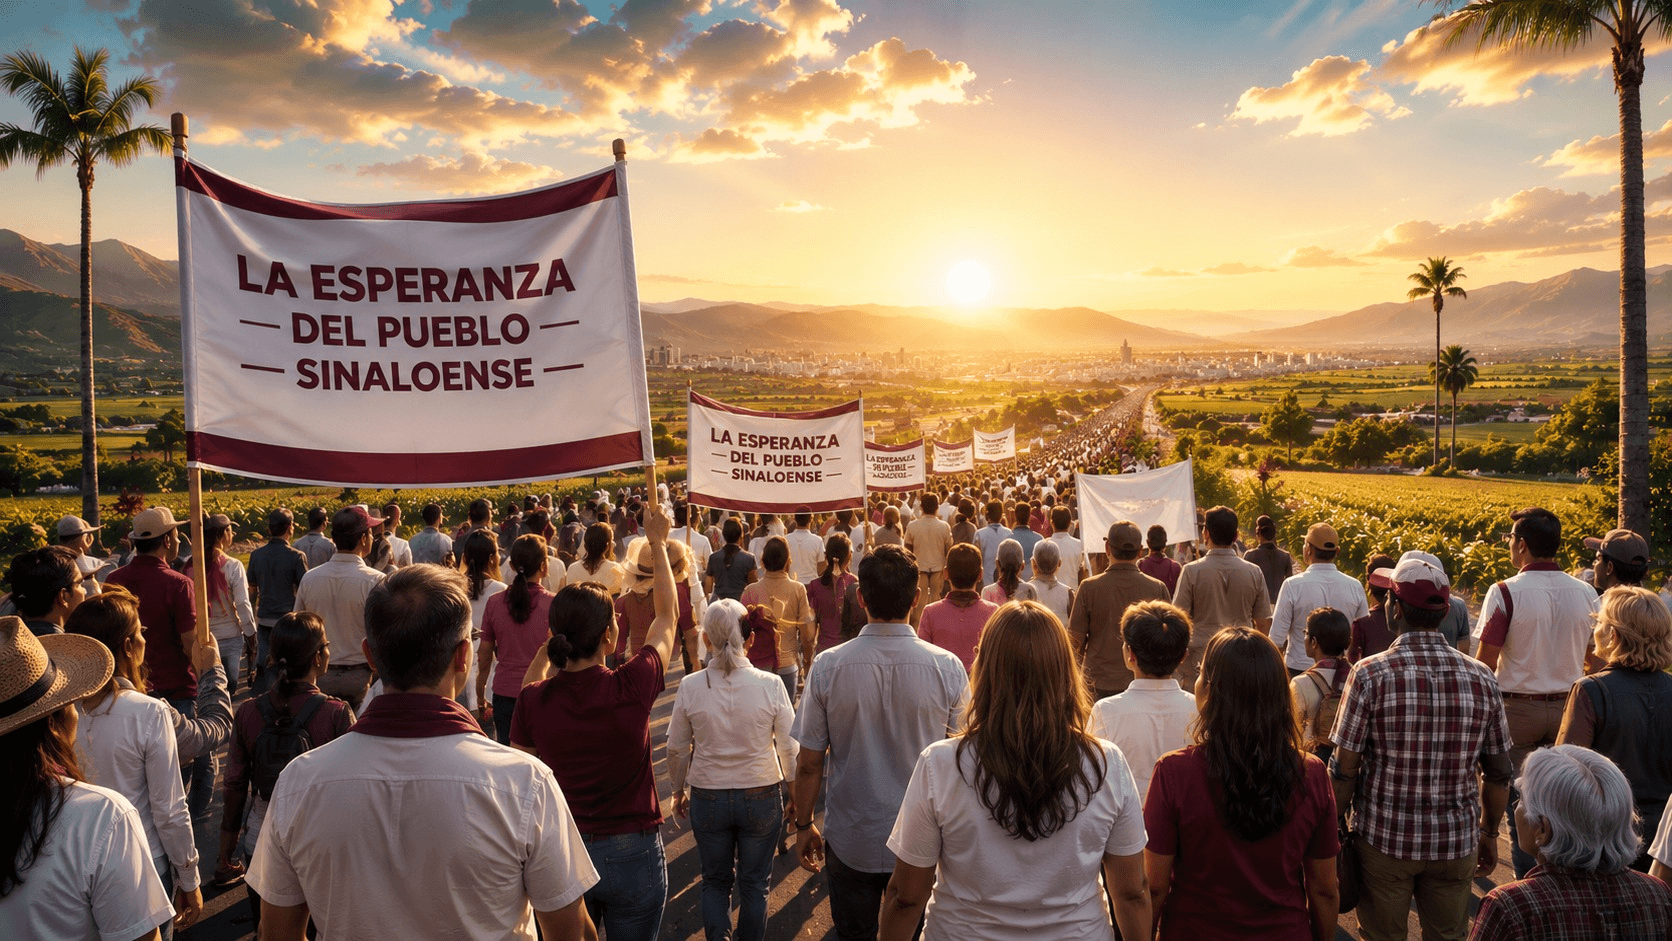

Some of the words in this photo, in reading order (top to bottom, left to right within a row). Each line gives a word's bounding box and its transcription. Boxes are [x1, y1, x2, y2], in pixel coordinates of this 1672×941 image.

[237, 254, 299, 298] LA
[310, 259, 576, 303] ESPERANZA
[292, 312, 366, 347] DEL
[377, 313, 530, 348] PUEBLO
[297, 358, 534, 392] SINALOENSE
[711, 428, 733, 445] LA
[738, 434, 839, 451] ESPERANZA
[731, 451, 759, 465] DEL
[764, 454, 822, 467] PUEBLO
[732, 468, 822, 483] SINALOENSE
